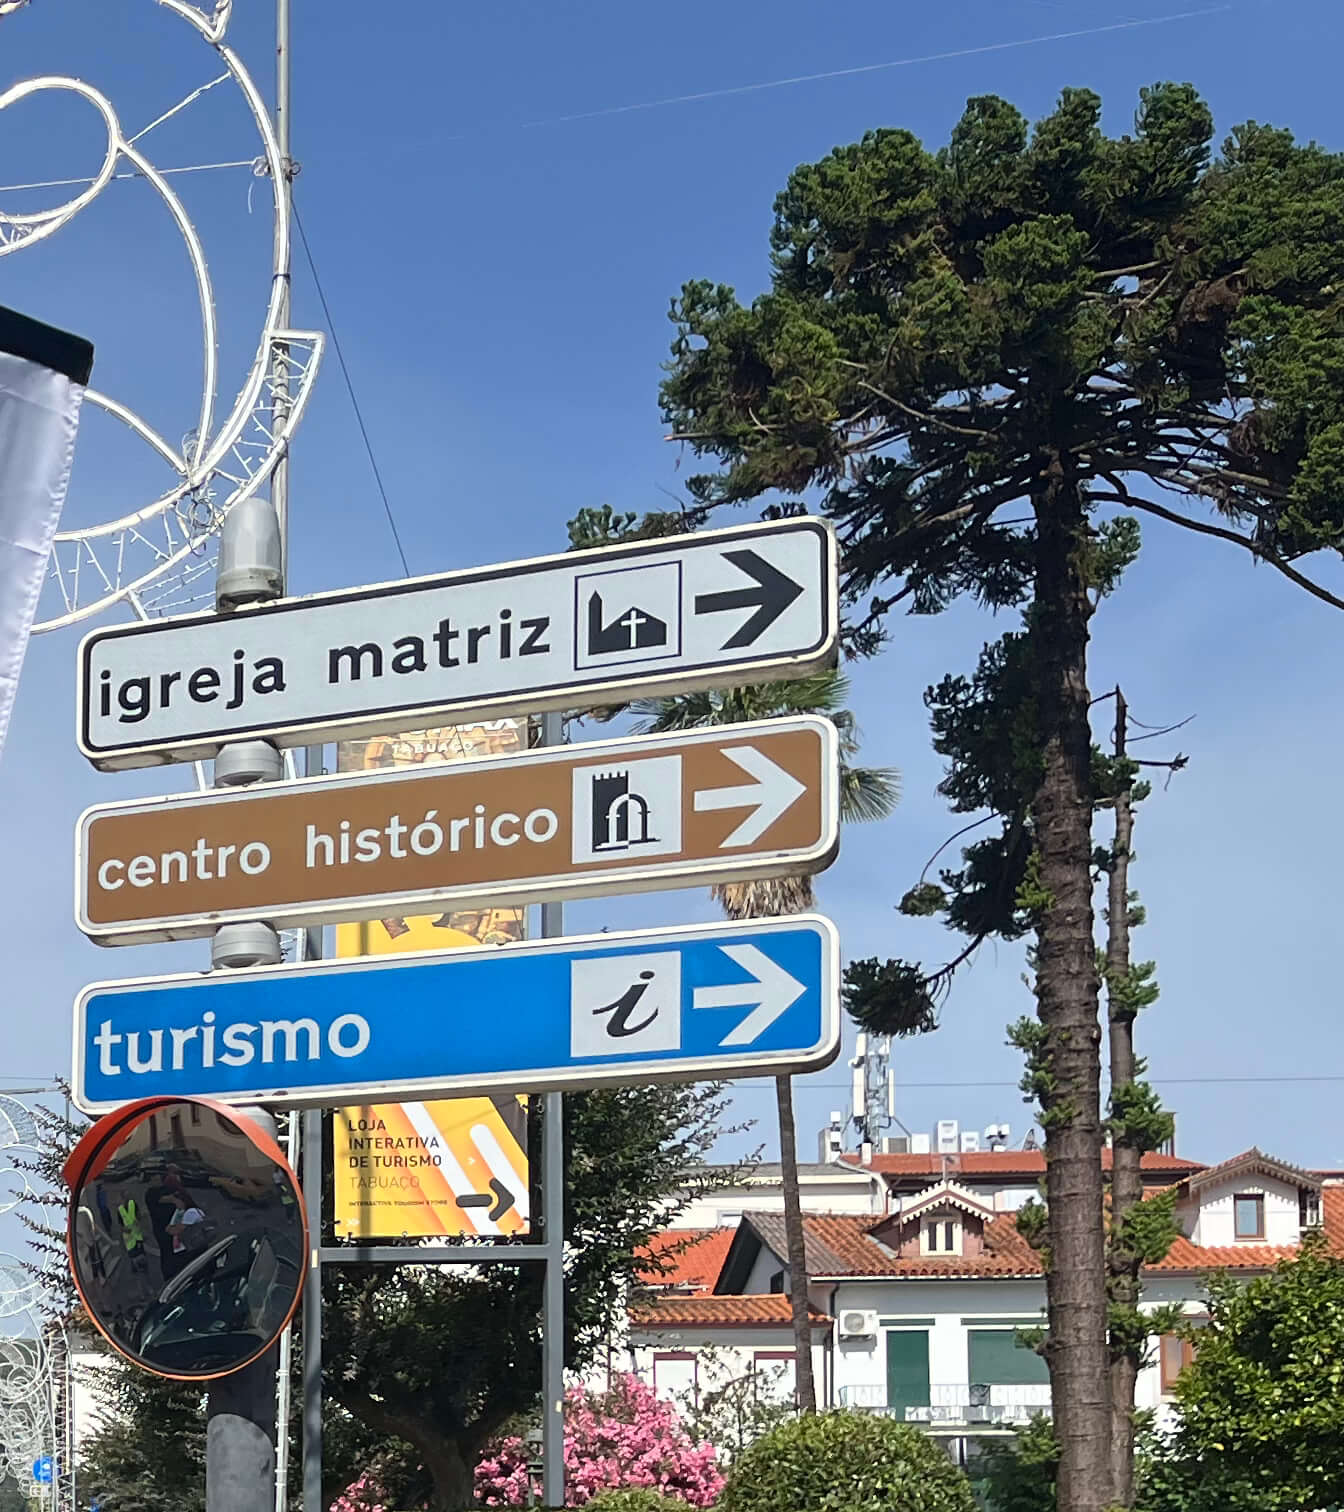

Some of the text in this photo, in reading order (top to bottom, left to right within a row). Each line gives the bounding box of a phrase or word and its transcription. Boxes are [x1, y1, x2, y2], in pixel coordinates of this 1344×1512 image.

[99, 608, 552, 724] igreja matriz
[96, 801, 559, 892] centro histórico
[93, 1010, 372, 1078] turismo
[348, 1119, 386, 1132] LOJA
[348, 1136, 440, 1150] INTERATIVA
[349, 1155, 442, 1168] DE TURISMO
[350, 1175, 420, 1191] TABUAÇO
